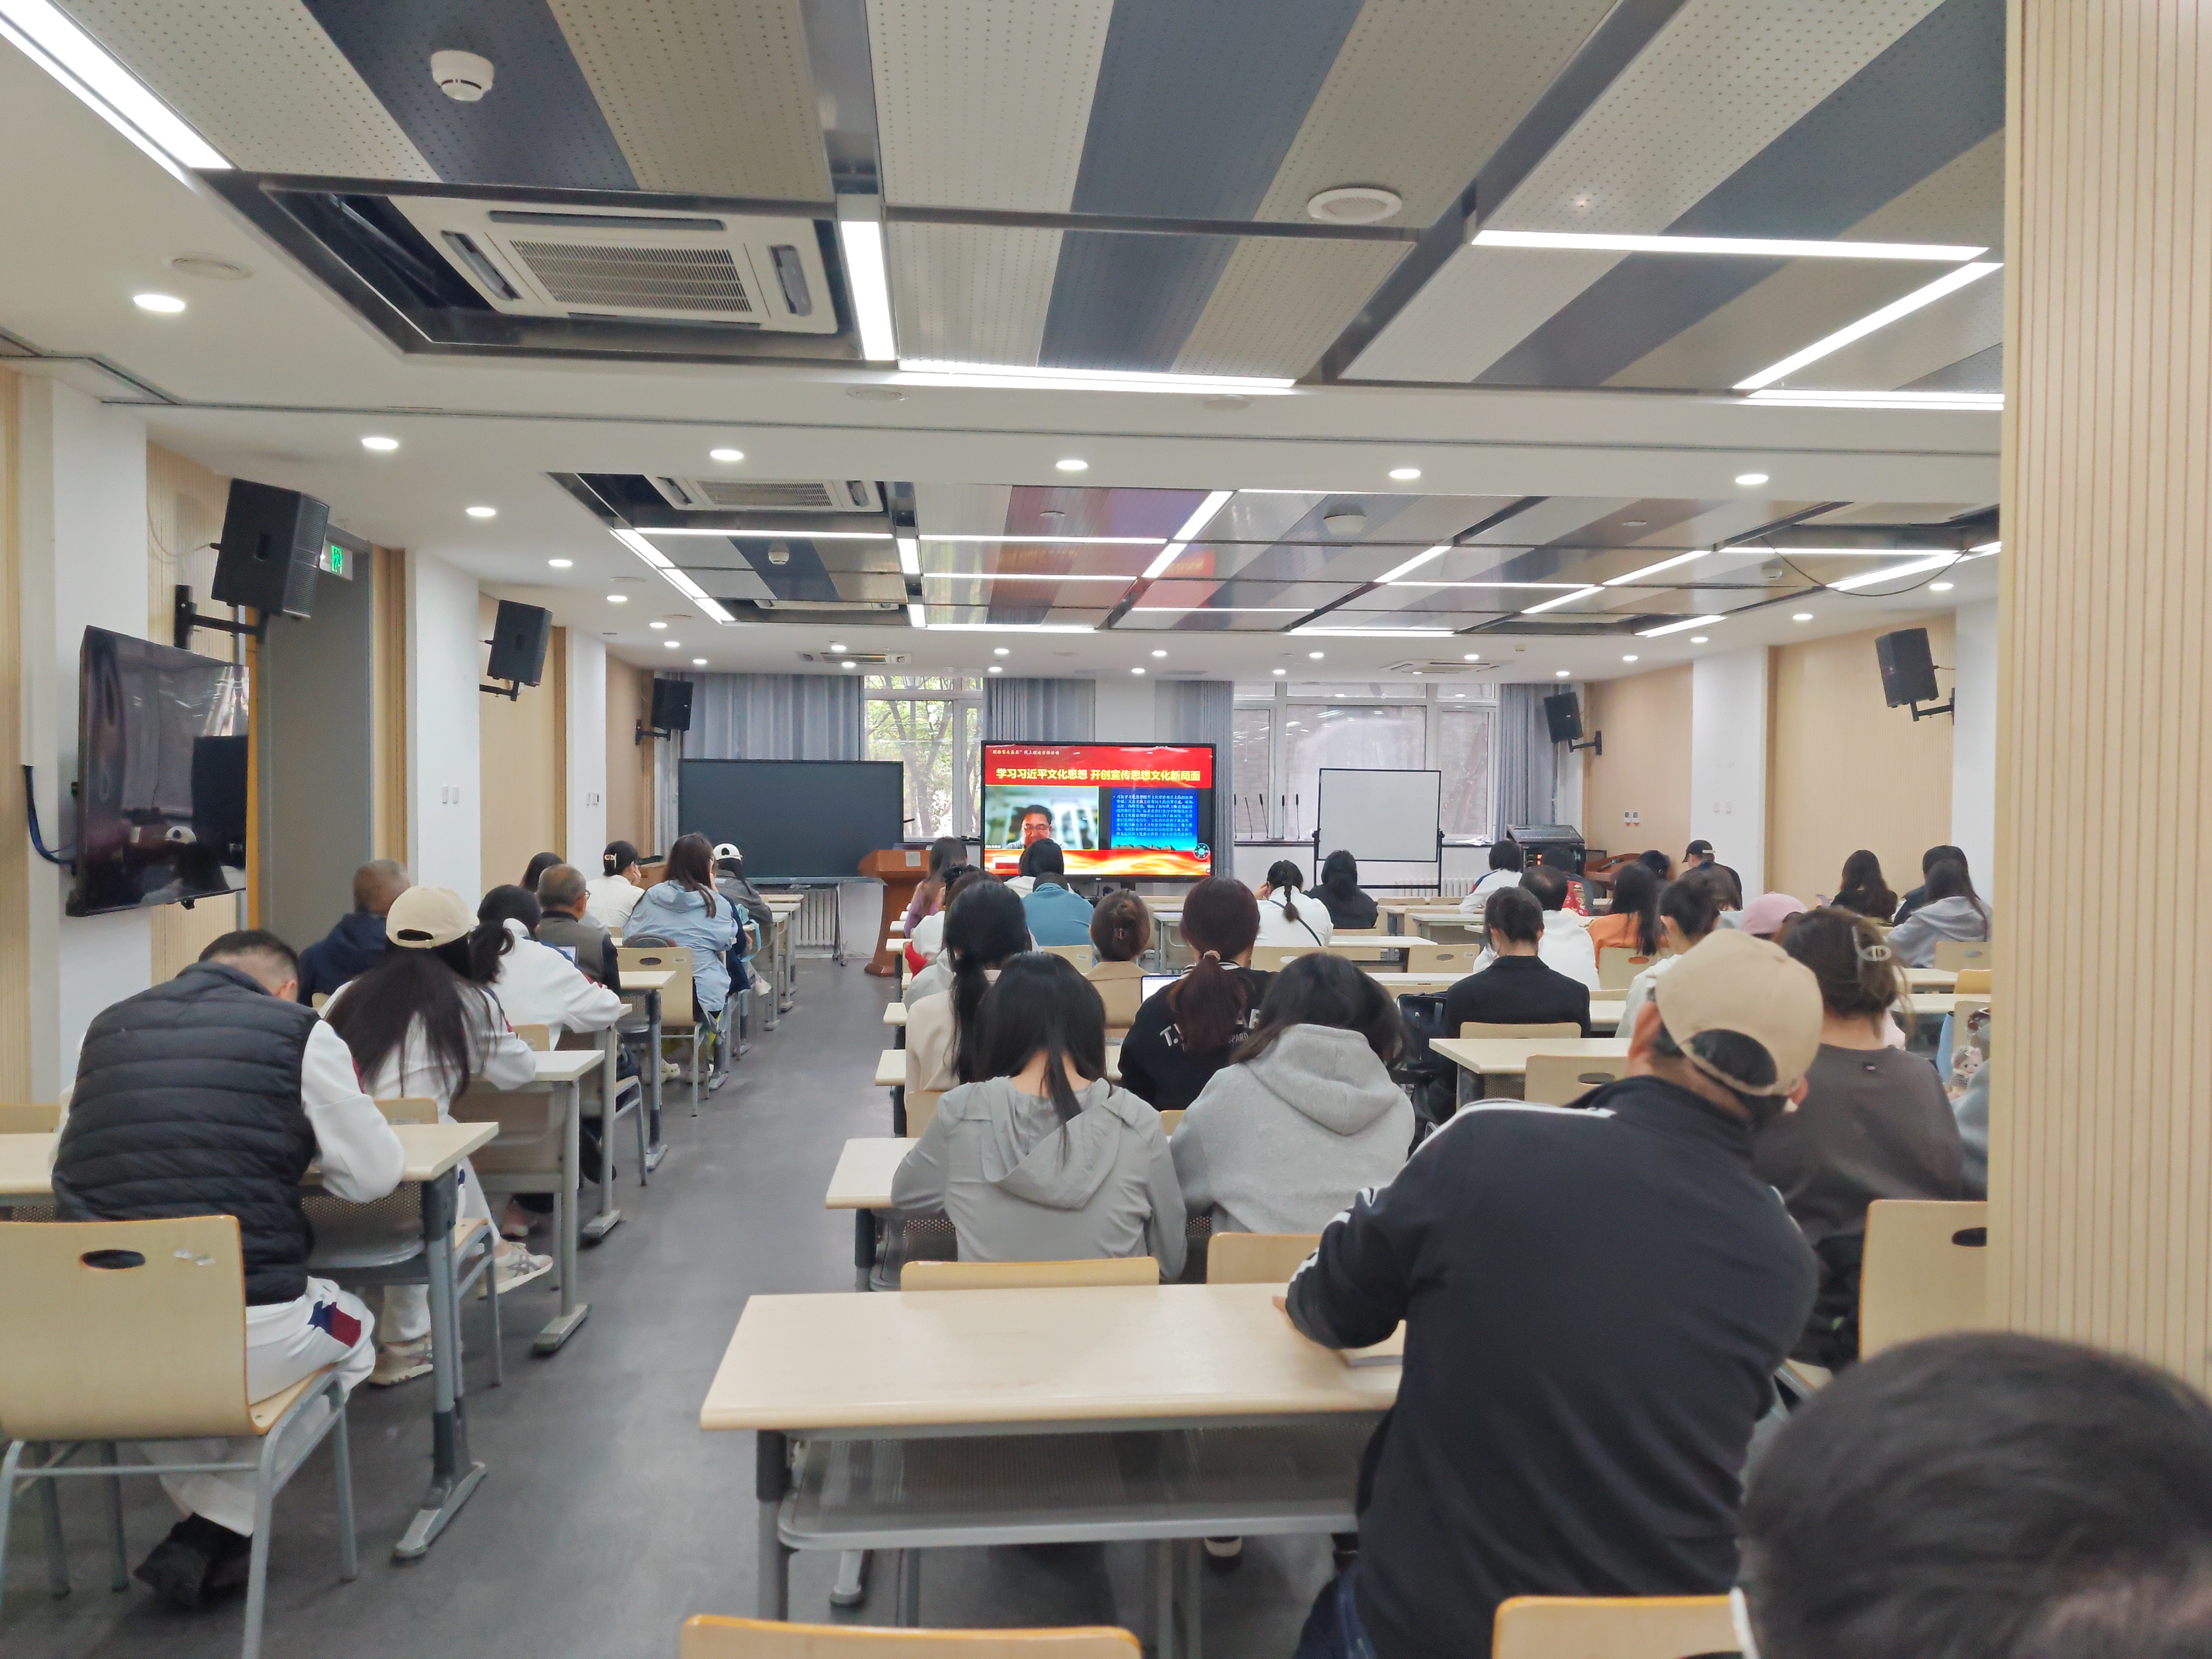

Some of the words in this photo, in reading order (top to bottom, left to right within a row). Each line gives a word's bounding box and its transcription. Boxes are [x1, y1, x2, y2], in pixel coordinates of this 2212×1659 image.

[996, 768, 1088, 780] 学习习近平文化思想
[1091, 769, 1201, 781] 开创宣传思想文化新局面
